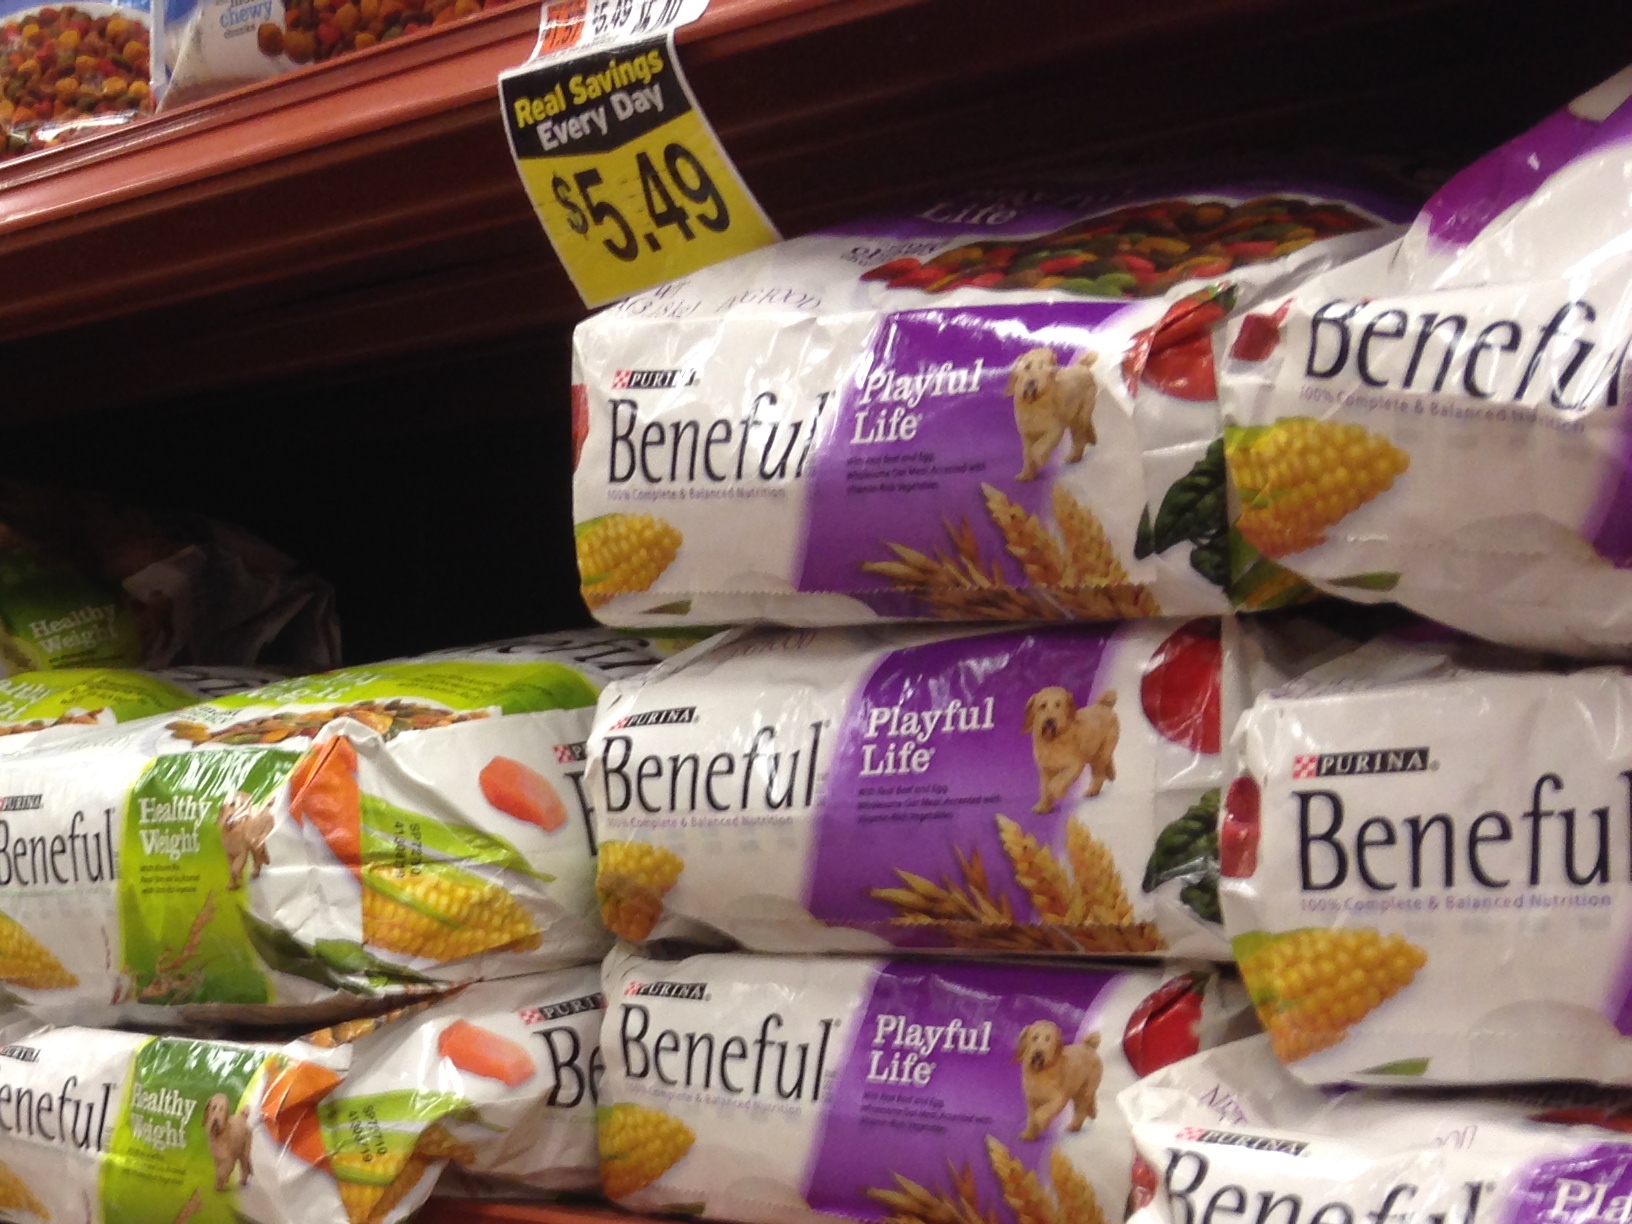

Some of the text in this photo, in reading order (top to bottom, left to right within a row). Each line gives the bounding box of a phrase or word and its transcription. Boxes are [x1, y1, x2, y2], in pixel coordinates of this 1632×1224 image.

[220, 3, 273, 26] chewy
[513, 49, 665, 128] Real Savings
[535, 82, 666, 151] Every Day
[551, 143, 732, 263] $5.49
[860, 358, 982, 409] Playful
[608, 390, 824, 486] Beneful
[851, 409, 919, 446] Life
[632, 489, 677, 502] Complete
[689, 488, 734, 501] Balanced
[29, 604, 116, 640] Healthy
[36, 623, 118, 654] Weight
[624, 706, 698, 729] PURINA
[867, 698, 995, 741] Playful
[601, 720, 827, 815] Beneful
[861, 745, 932, 777] Life
[1316, 747, 1430, 777] PURINA
[137, 795, 213, 829] Healthy
[630, 816, 678, 830] Complete
[691, 815, 739, 829] Balanced
[140, 827, 200, 861] Weight
[1302, 893, 1611, 913] 100% Complete & Balanced Nutrition
[542, 993, 605, 1018] PURI
[635, 982, 707, 1000] PURINA
[873, 1014, 991, 1056] Playful
[619, 1003, 834, 1103] Beneful
[868, 1050, 933, 1088] Life
[130, 1082, 198, 1124] Healthy
[130, 1116, 186, 1151] Weight
[1200, 1128, 1308, 1157] PURINA
